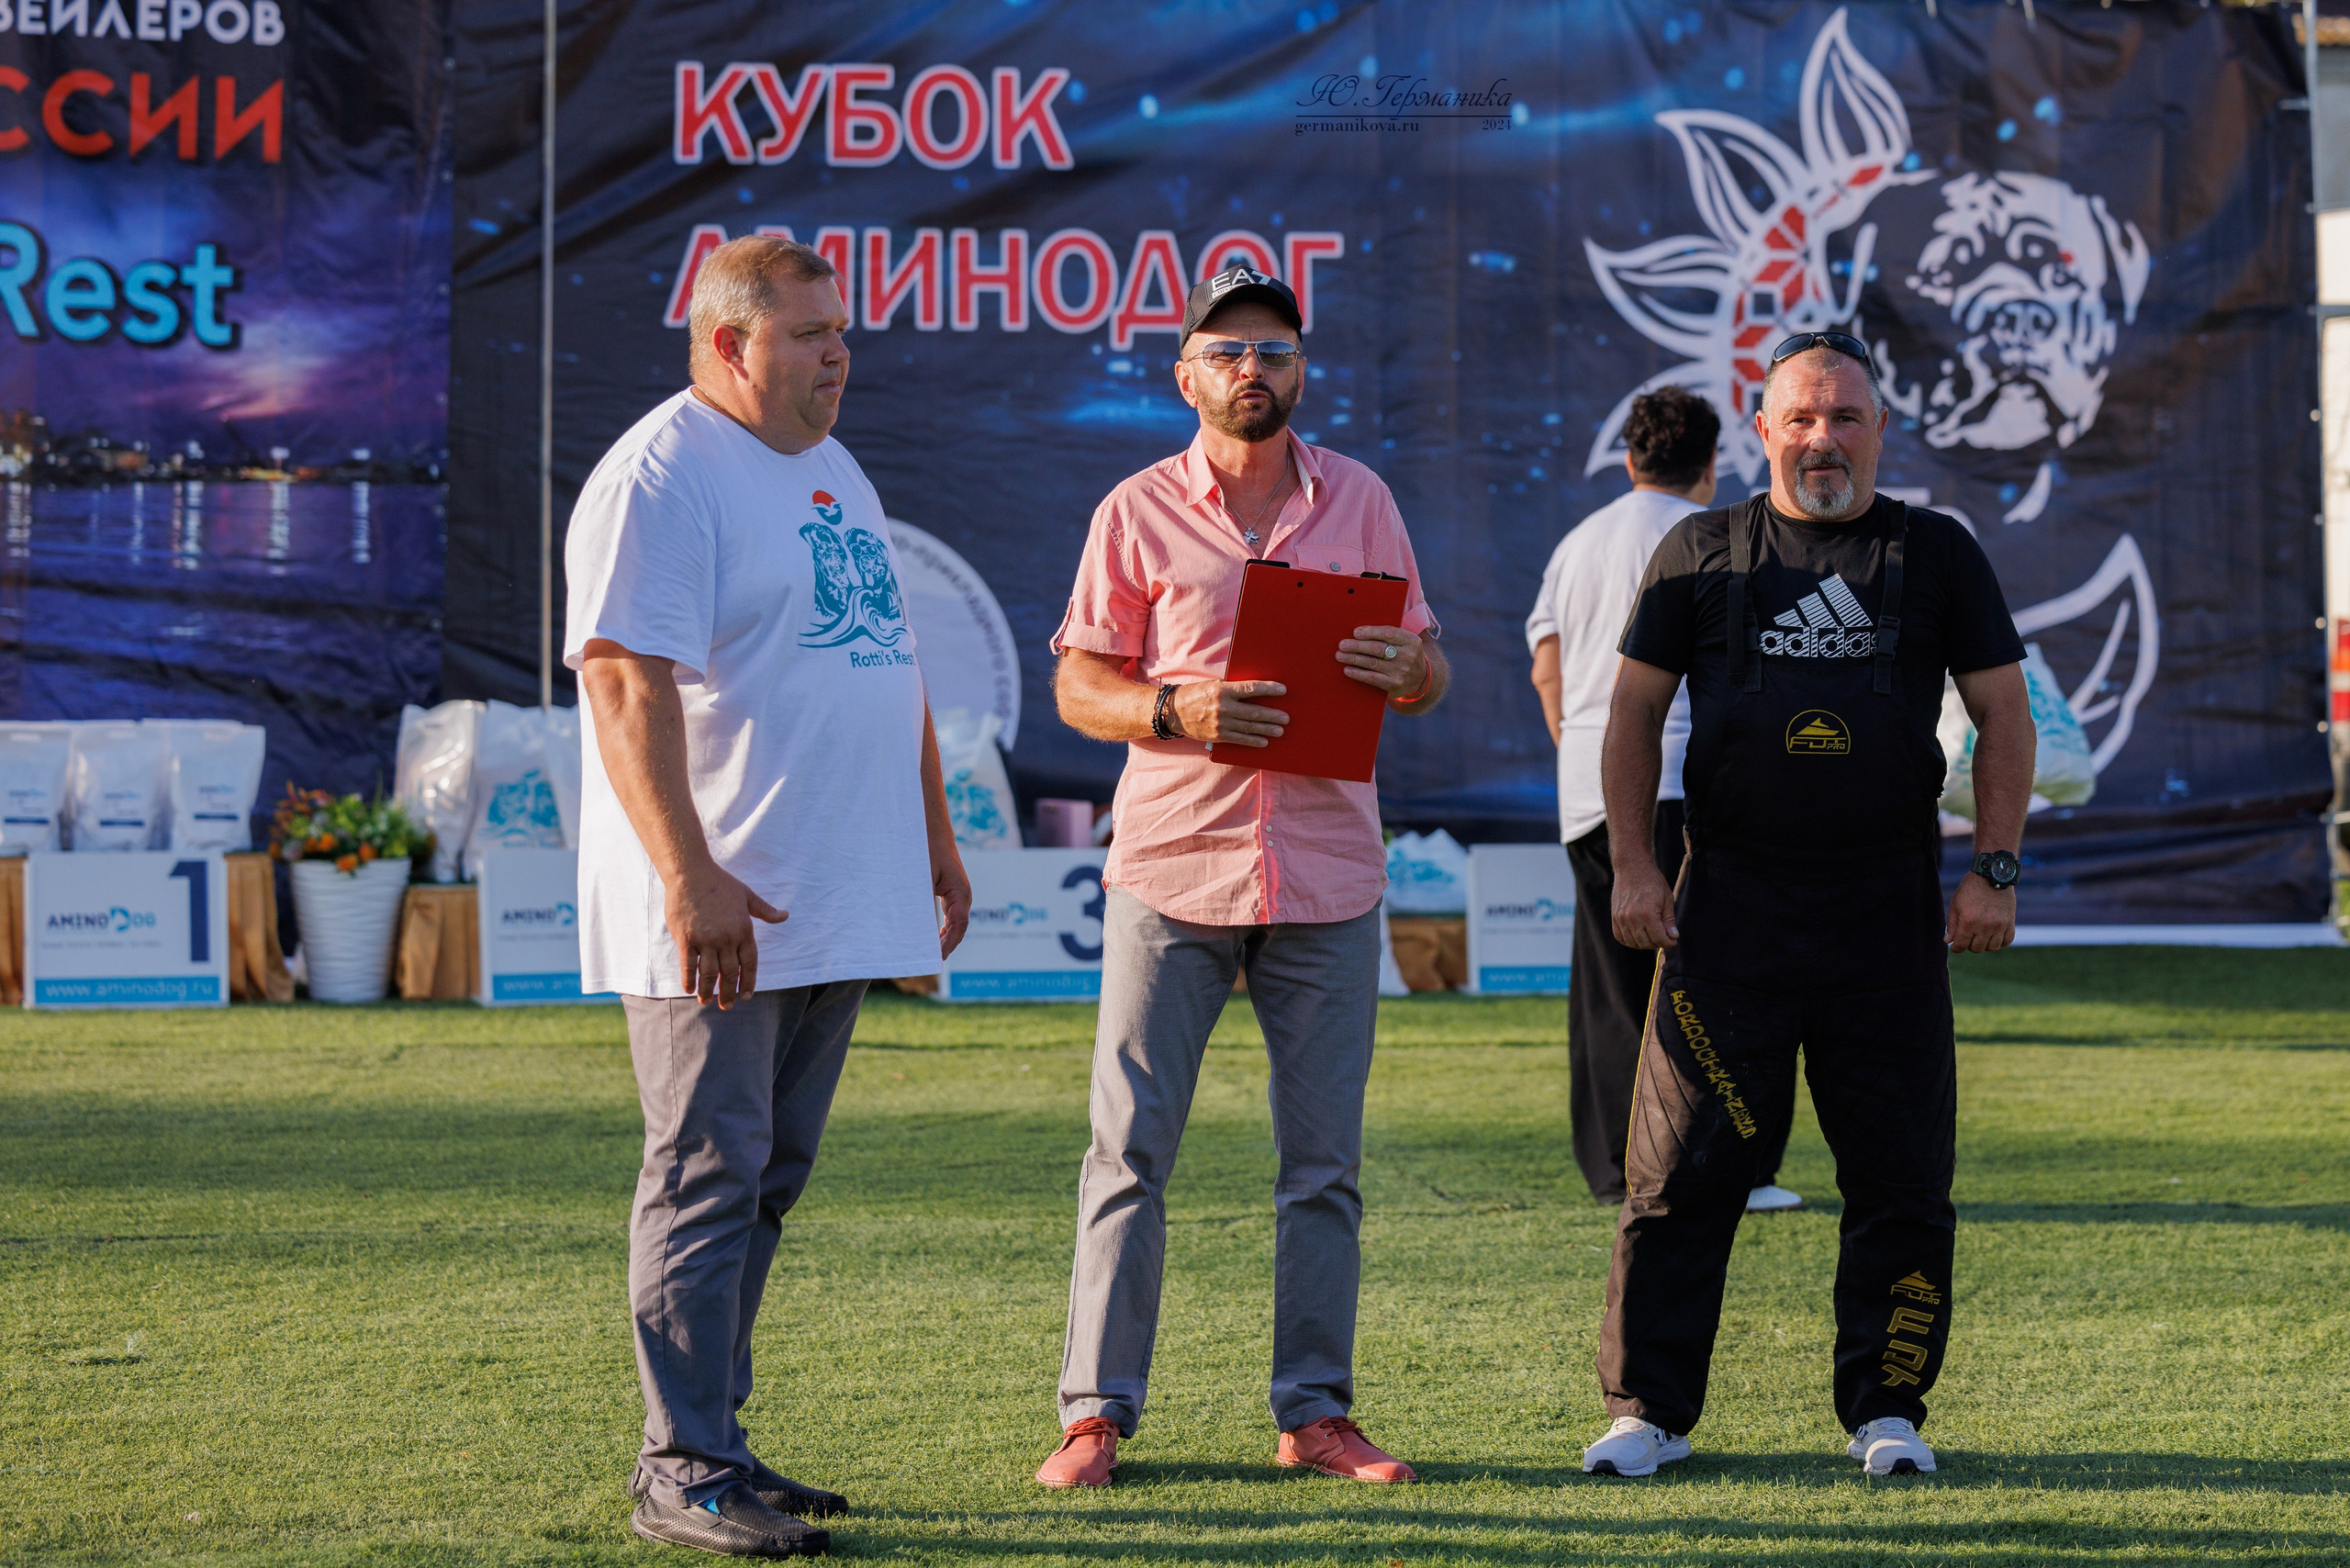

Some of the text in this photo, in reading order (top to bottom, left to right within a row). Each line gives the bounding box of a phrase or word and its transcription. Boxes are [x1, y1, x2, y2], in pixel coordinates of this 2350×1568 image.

[674, 61, 1074, 171] КУБОК
[0, 221, 234, 346] Rest
[1212, 268, 1271, 292] EA7
[850, 649, 916, 668] Rotti's Rest
[169, 860, 209, 963] 1
[1060, 865, 1107, 961] 3
